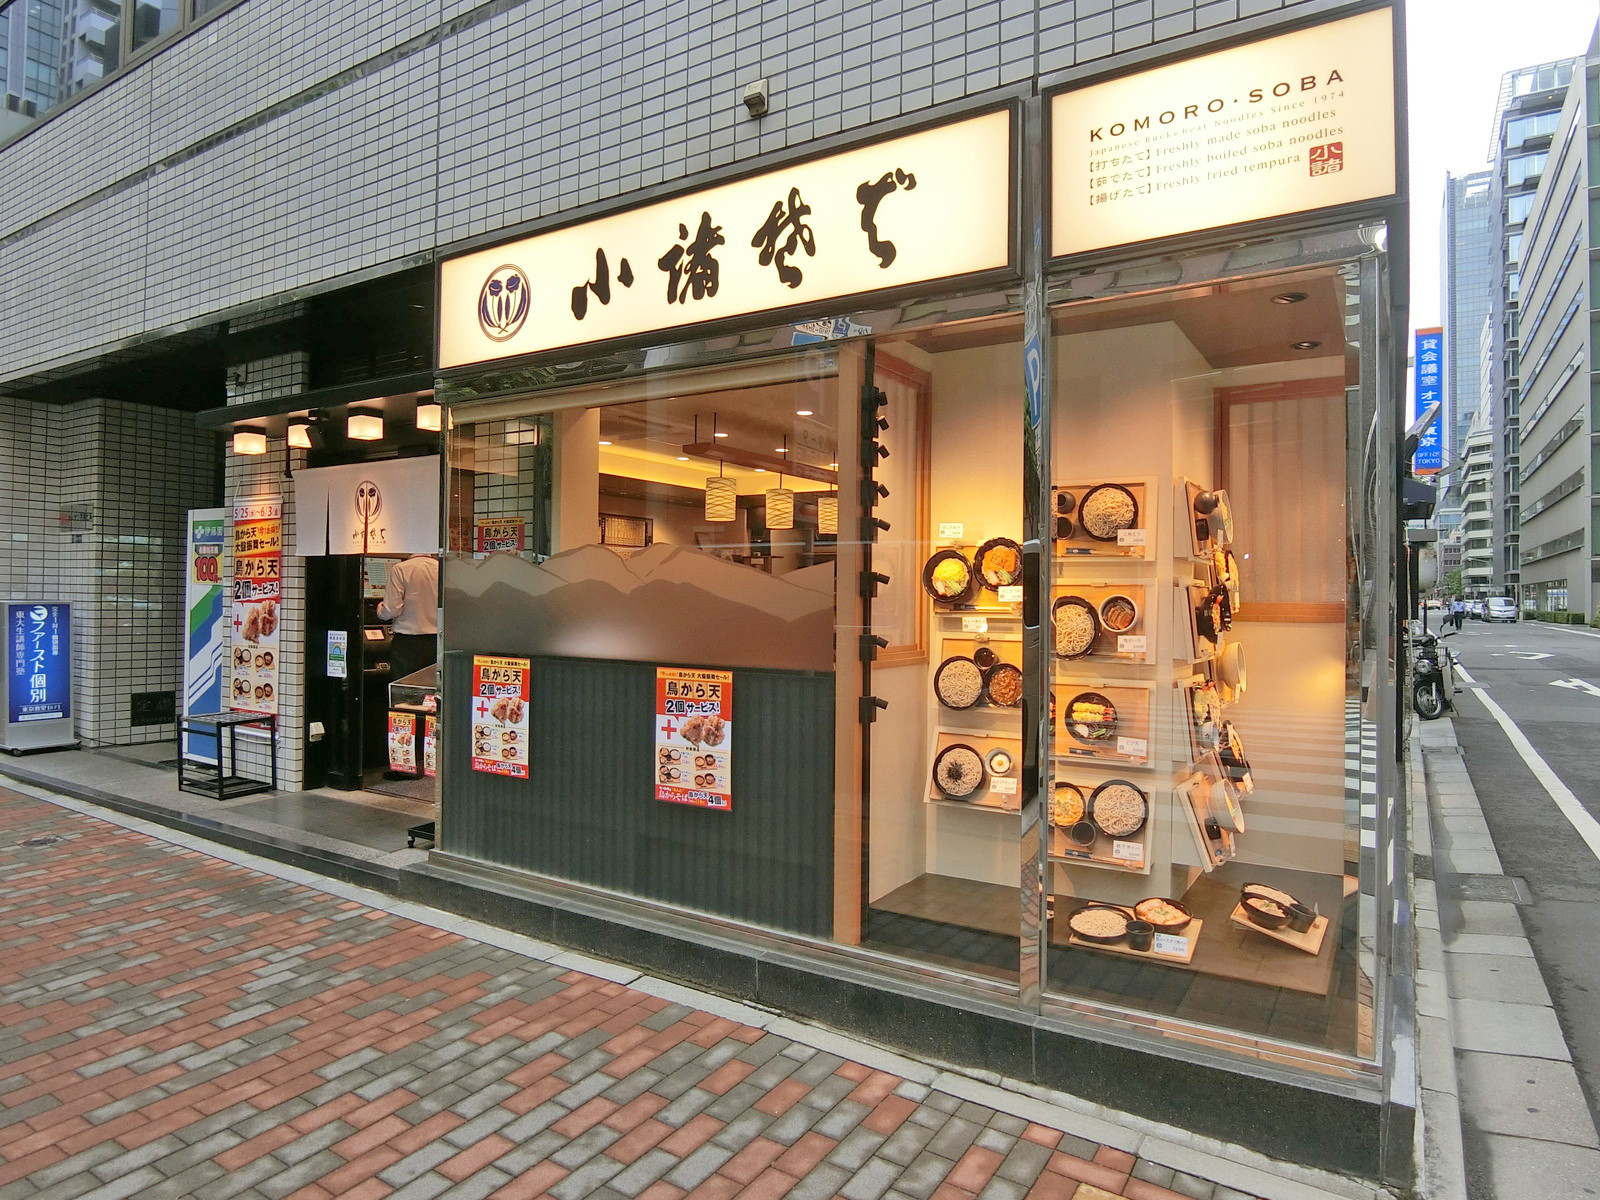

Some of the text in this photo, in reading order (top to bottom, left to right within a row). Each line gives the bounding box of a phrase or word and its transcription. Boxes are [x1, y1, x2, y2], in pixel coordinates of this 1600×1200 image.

[1089, 140, 1139, 158] Japanese
[1214, 111, 1264, 127] Noodles
[1270, 100, 1305, 114] Since
[1314, 90, 1344, 104] 1974
[1156, 139, 1201, 157] Freshly
[1207, 131, 1241, 145] made
[1246, 122, 1276, 137] soba
[1282, 109, 1336, 129] noodles
[1156, 157, 1201, 174] Freshly
[1207, 146, 1247, 163] boiled
[1253, 140, 1283, 153] soba
[1289, 126, 1344, 145] noodles
[1156, 174, 1201, 191] Freshly
[1207, 166, 1238, 180] fried
[1244, 154, 1301, 172] tempura
[234, 559, 278, 576] 鳥から天
[29, 621, 47, 703] ファースト個別
[481, 667, 522, 683] 鳥から天
[480, 683, 521, 696] 2個サービス!
[667, 681, 721, 699] 鳥から天
[666, 699, 720, 714] 2個サービス!
